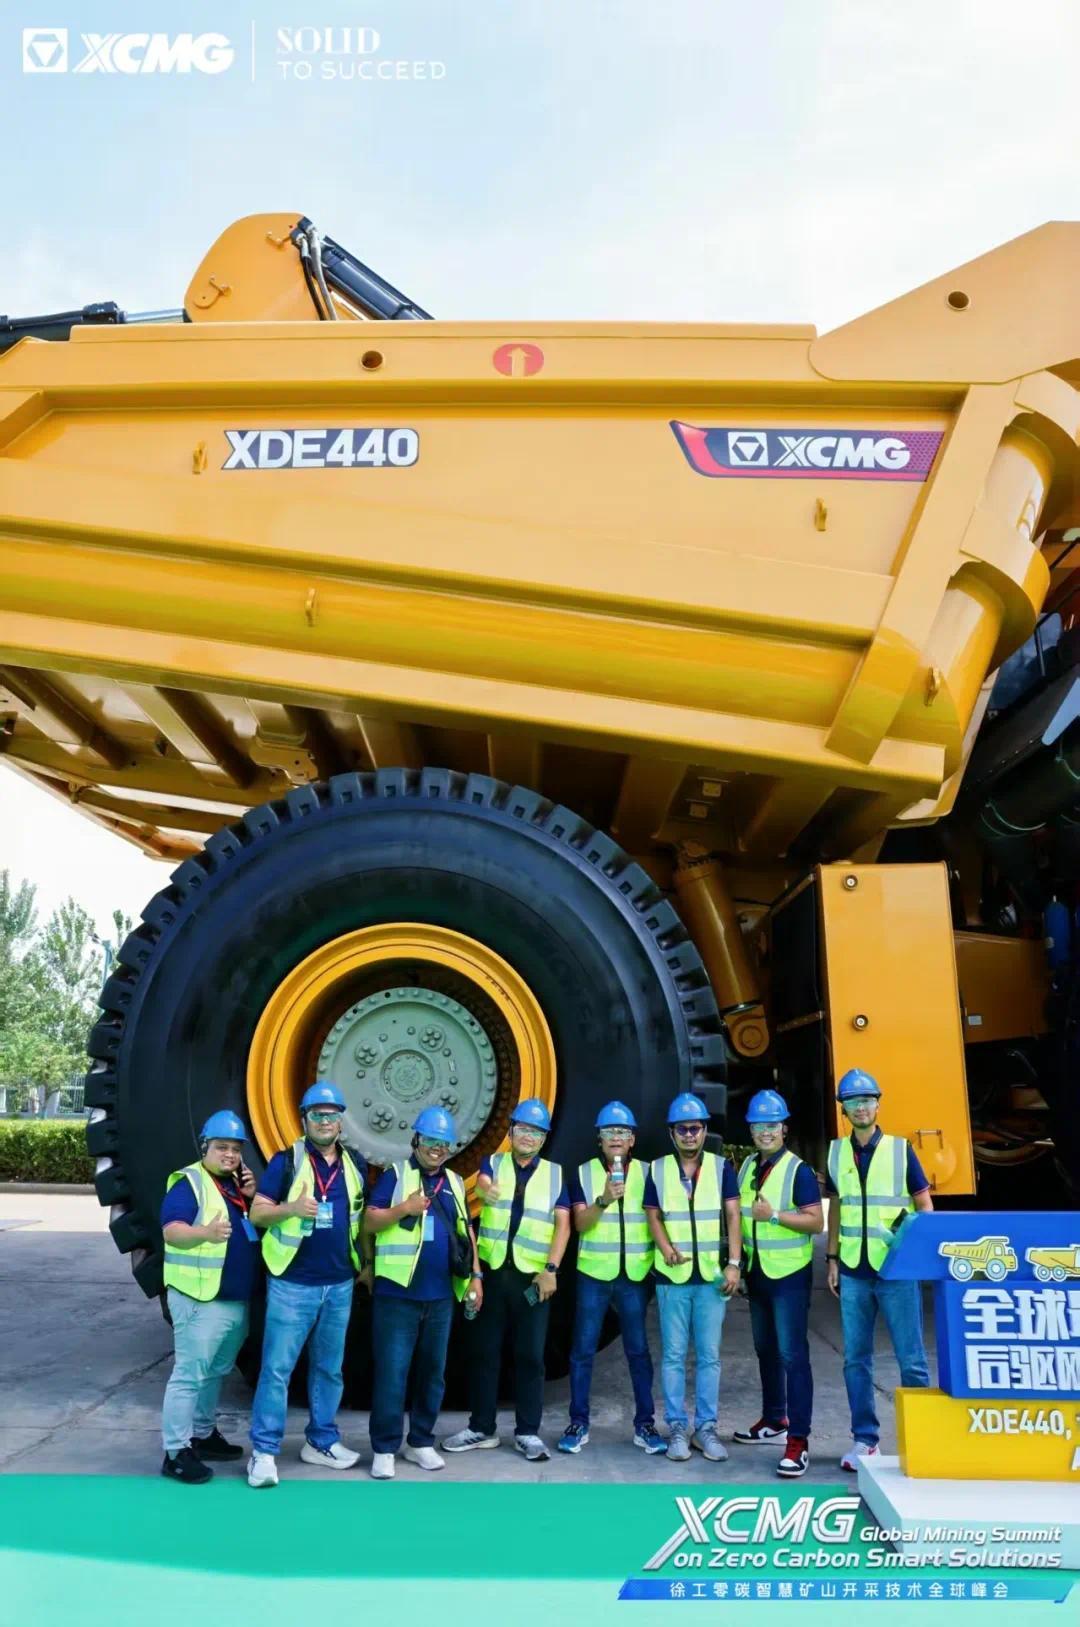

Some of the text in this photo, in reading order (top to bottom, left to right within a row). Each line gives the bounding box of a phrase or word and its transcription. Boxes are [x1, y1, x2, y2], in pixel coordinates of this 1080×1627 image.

[222, 428, 420, 470] XDE440
[773, 435, 911, 471] XCMG
[961, 1288, 1080, 1341] 全球
[968, 1408, 1073, 1441] XDE440,
